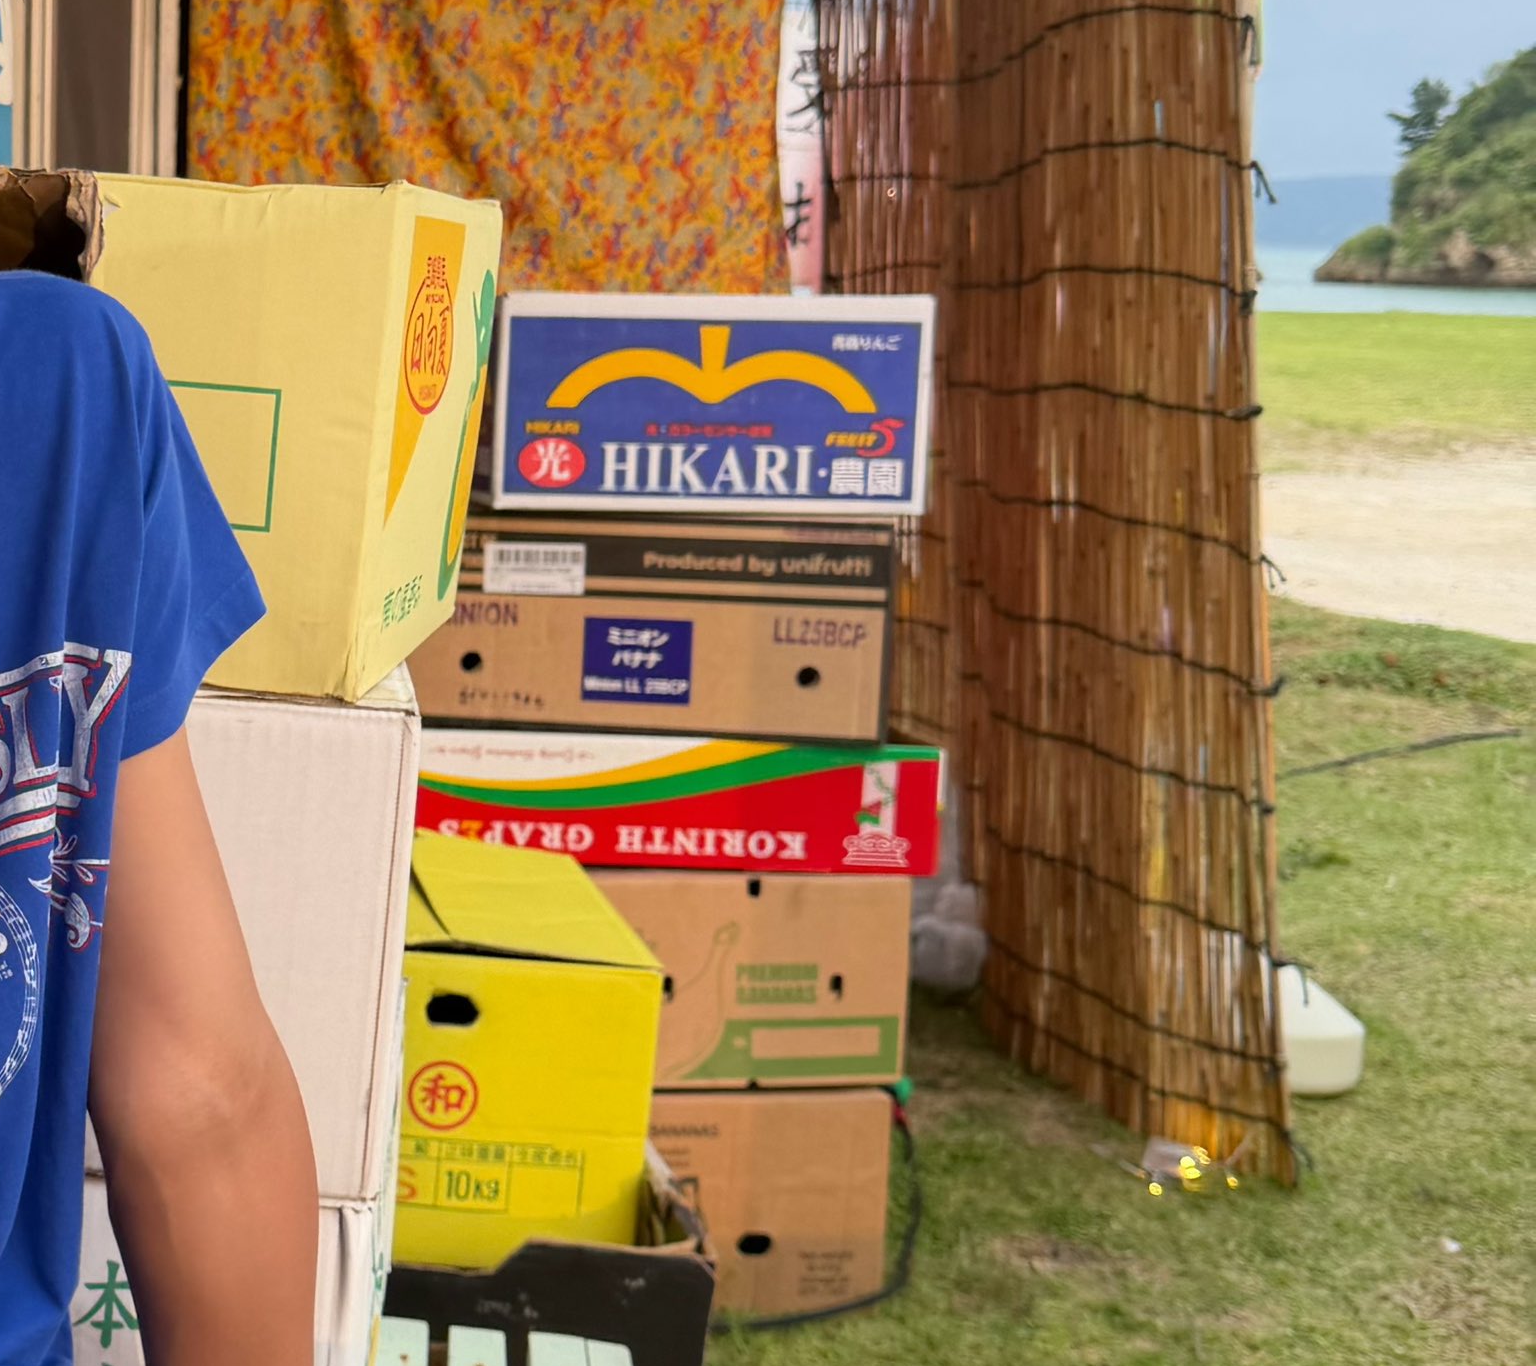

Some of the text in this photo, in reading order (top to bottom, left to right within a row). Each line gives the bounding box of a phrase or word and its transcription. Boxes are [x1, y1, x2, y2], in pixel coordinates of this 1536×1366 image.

[525, 420, 581, 436] HIKARI
[531, 437, 571, 482] 光
[642, 550, 873, 578] Produced by unifrutti
[606, 625, 670, 647] ミニオン
[617, 824, 808, 860] KORINTH
[420, 1073, 467, 1115] 和
